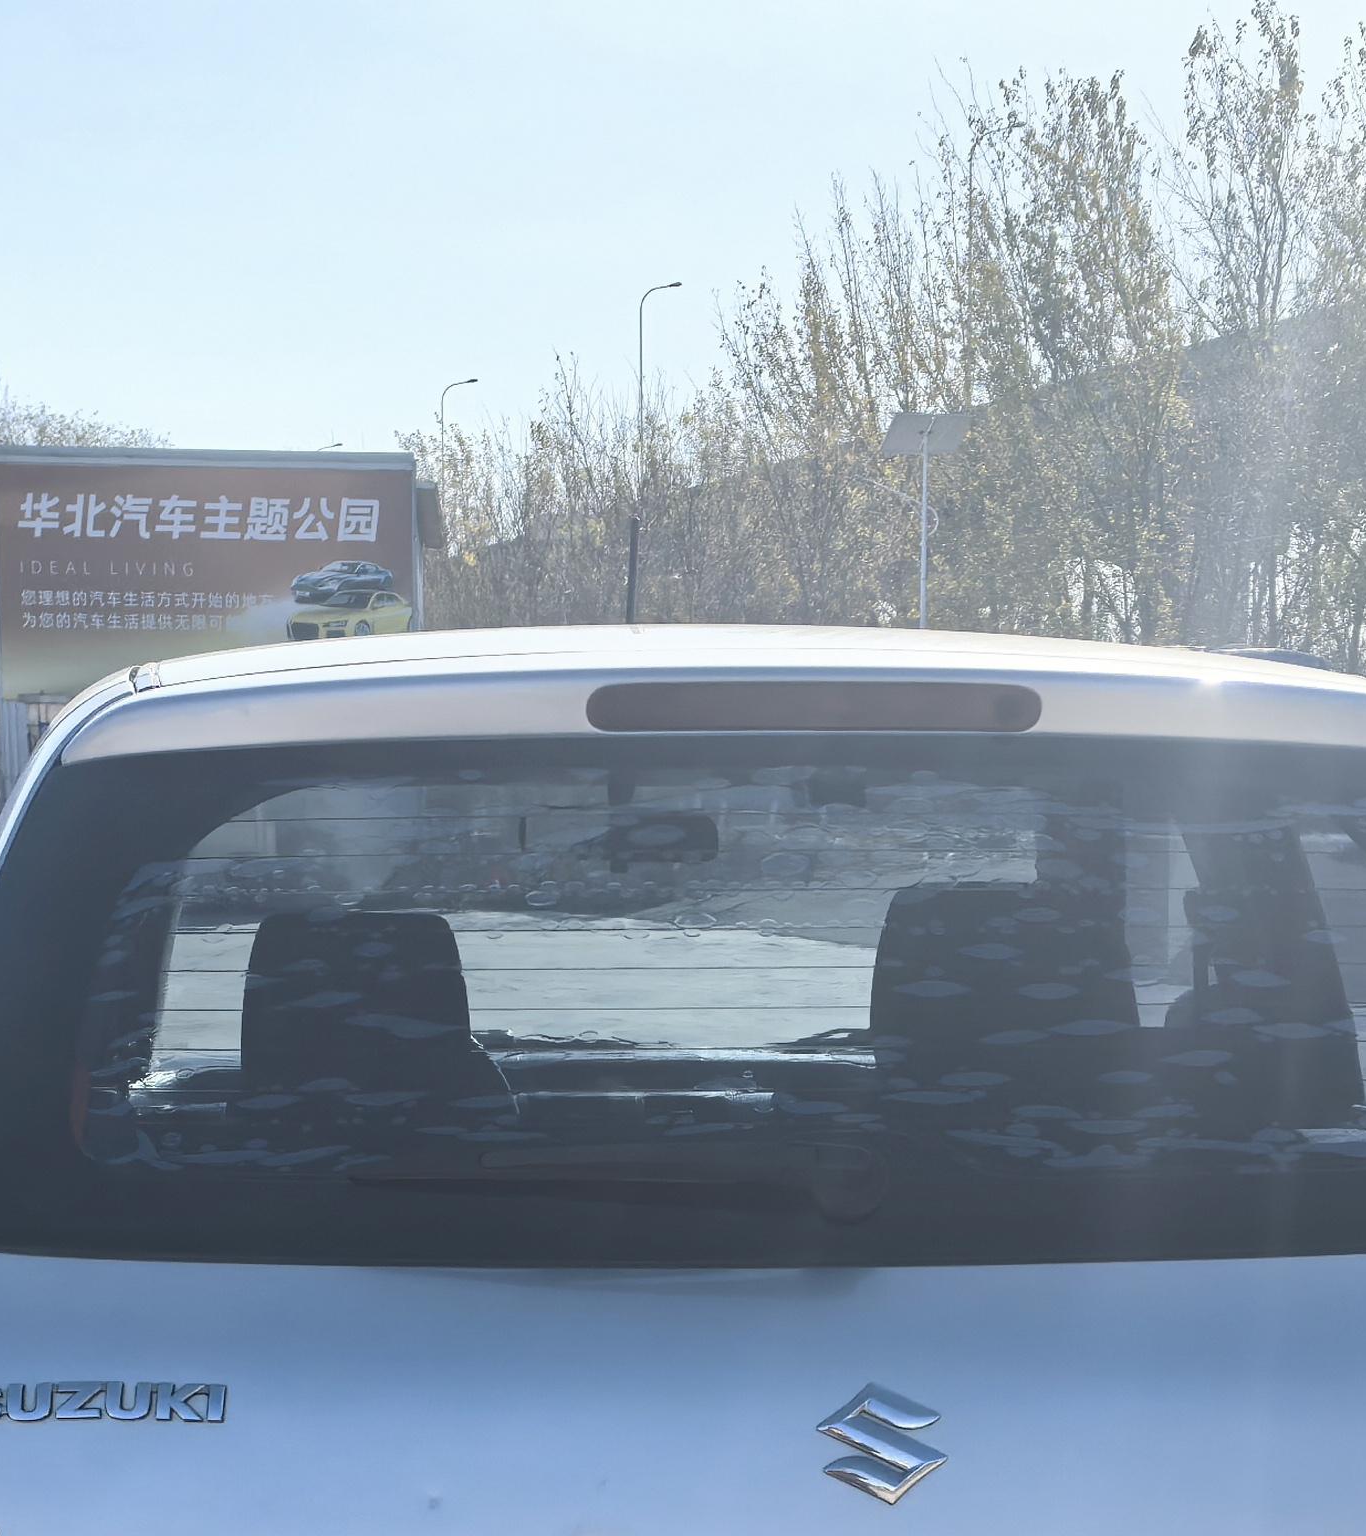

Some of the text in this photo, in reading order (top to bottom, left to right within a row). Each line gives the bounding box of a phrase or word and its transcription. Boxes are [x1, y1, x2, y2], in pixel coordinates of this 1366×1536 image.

[17, 492, 380, 543] 华北汽车主题公园
[19, 560, 195, 577] IDEAL LIVING
[22, 611, 237, 632] 为您的汽车生活提供无限可
